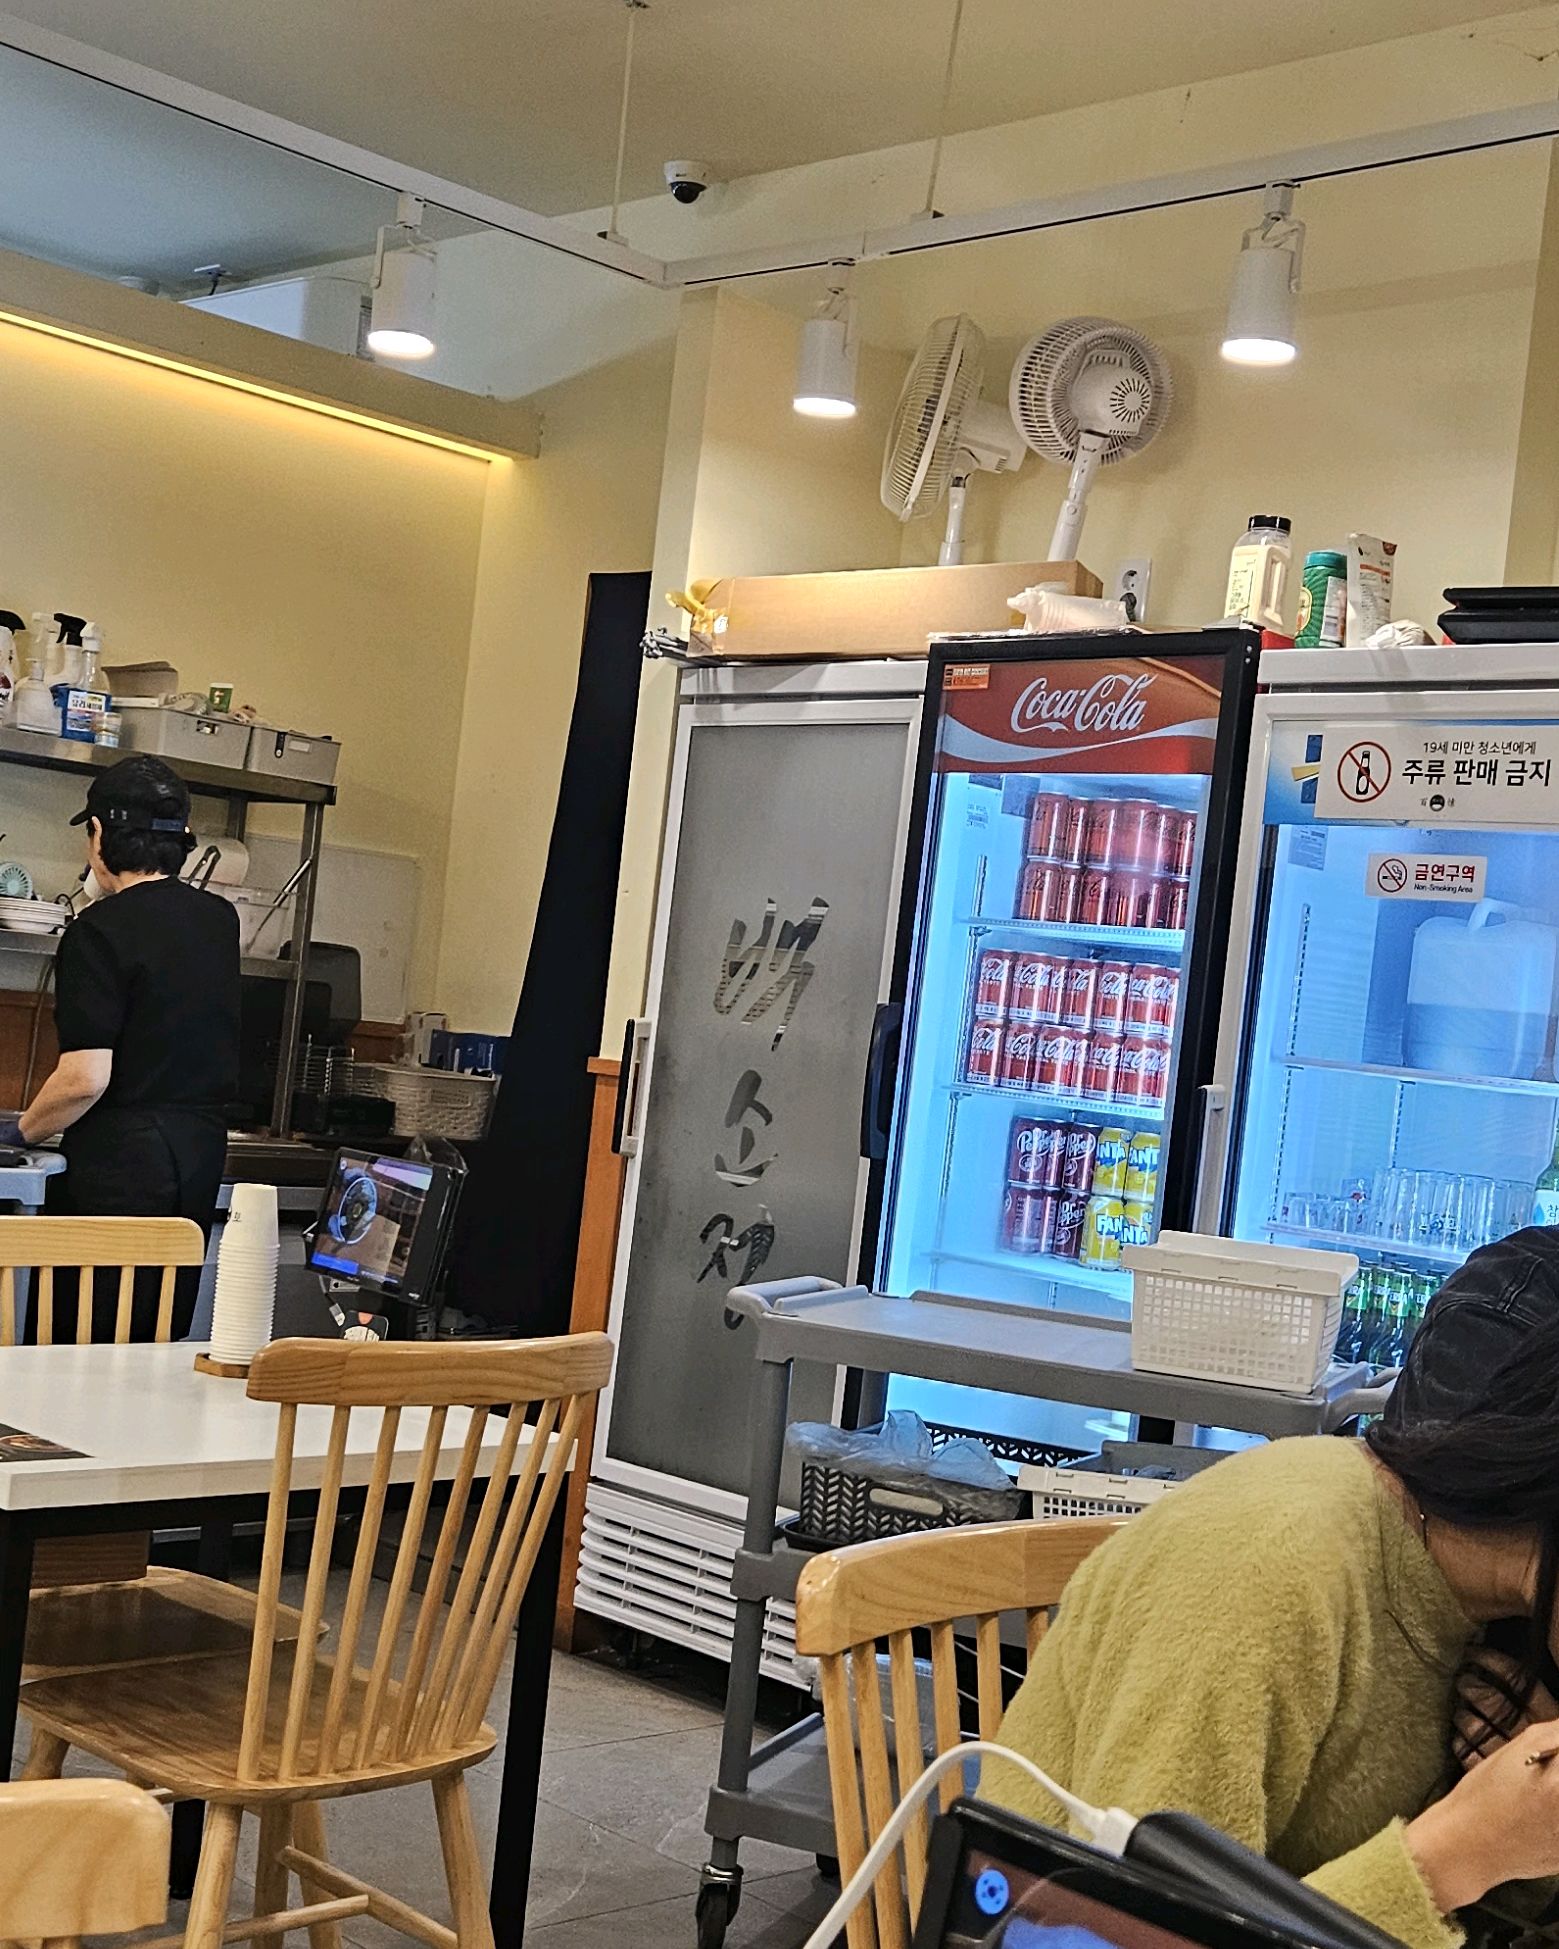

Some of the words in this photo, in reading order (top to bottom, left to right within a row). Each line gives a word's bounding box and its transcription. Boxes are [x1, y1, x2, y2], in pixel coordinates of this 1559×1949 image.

[1011, 673, 1158, 733] Coca-Cola
[1423, 741, 1449, 755] 19세
[1452, 741, 1475, 755] 미만
[1478, 741, 1537, 755] 청소년에게
[1402, 759, 1446, 786] 주류
[1453, 759, 1499, 786] 판매
[1505, 759, 1552, 787] 금지
[1415, 864, 1476, 883] 금연구역
[1457, 885, 1474, 894] Area
[1097, 1141, 1126, 1160] NTA
[1129, 1147, 1160, 1165] ANT
[1097, 1214, 1123, 1234] FAN
